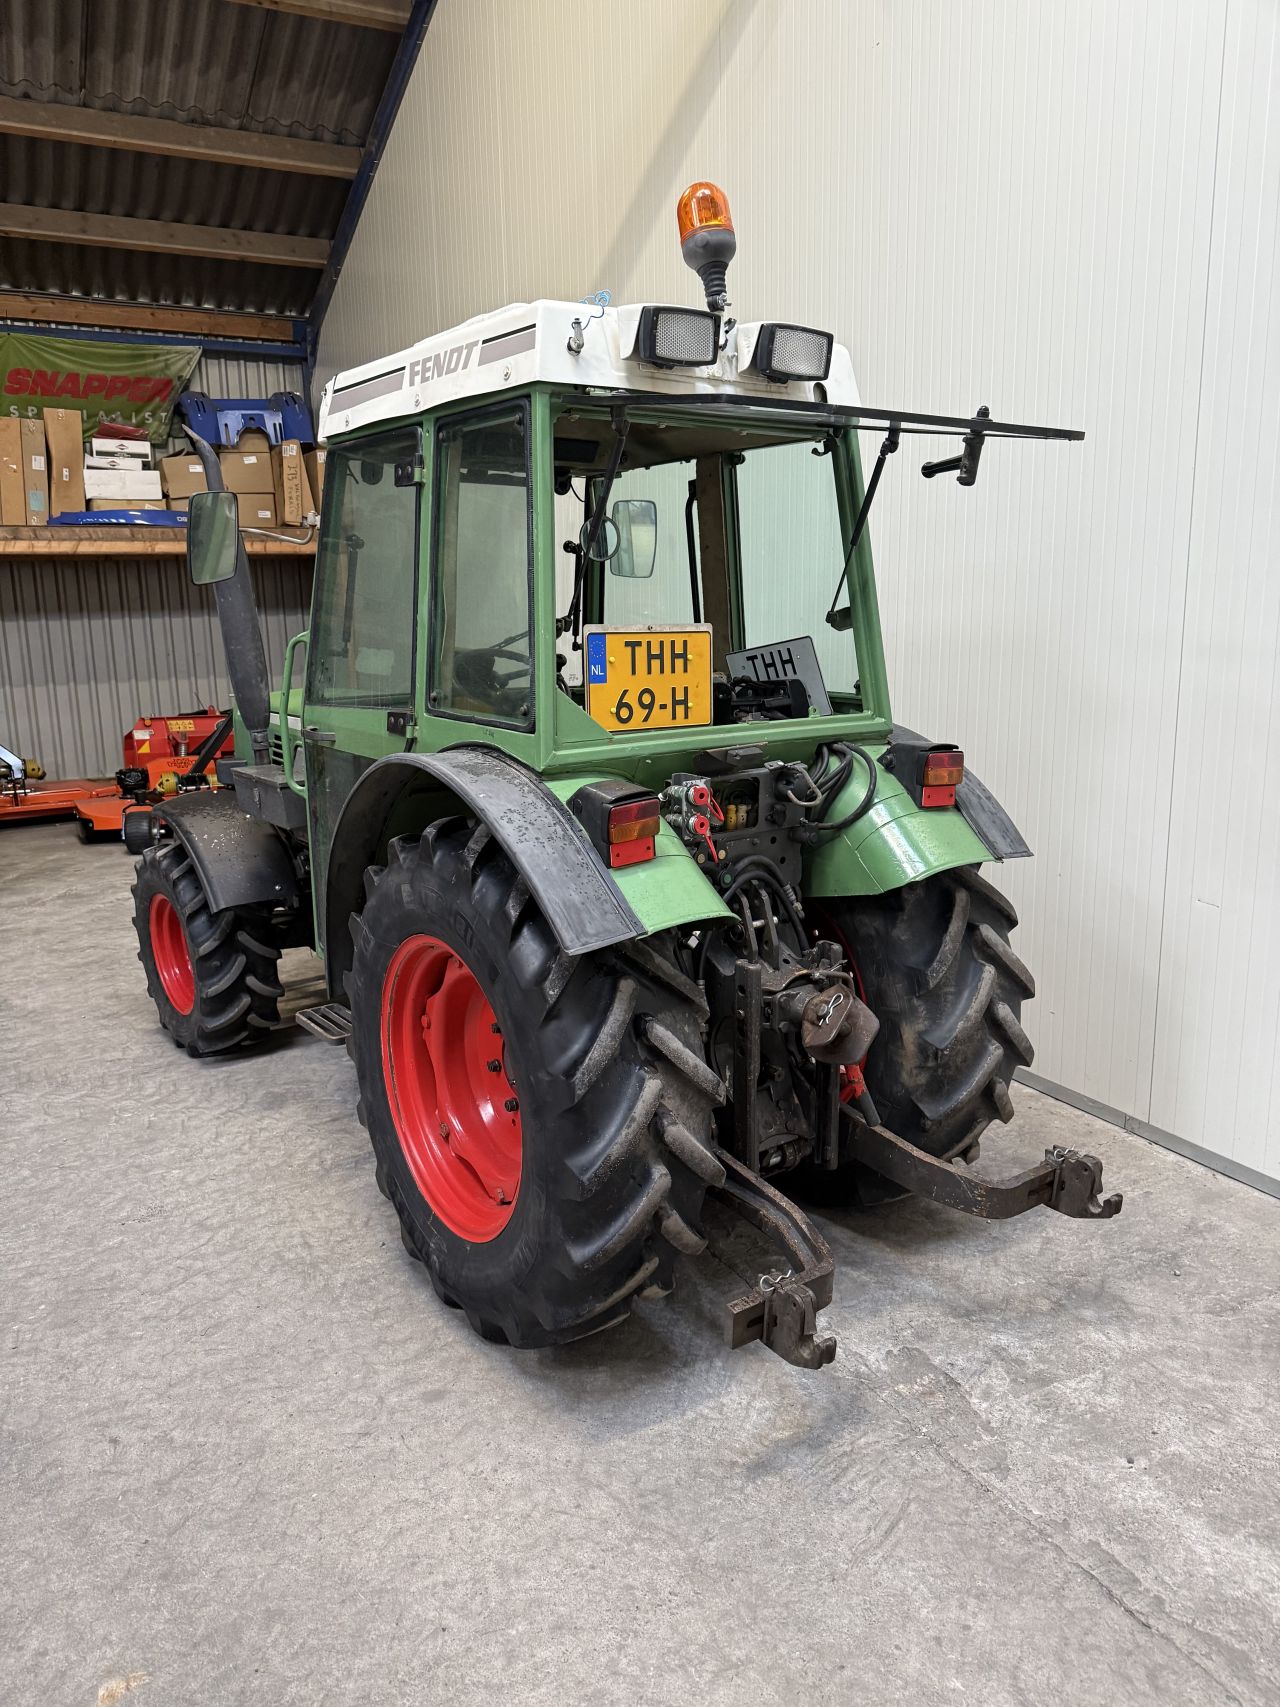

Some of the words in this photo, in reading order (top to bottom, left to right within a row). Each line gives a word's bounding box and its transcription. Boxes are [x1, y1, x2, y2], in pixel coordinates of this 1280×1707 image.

[409, 340, 479, 387] FENDT
[4, 368, 173, 404] SNAPPER
[9, 405, 168, 424] SPIAIST
[591, 665, 605, 676] NL
[624, 639, 688, 676] THH
[746, 647, 797, 682] THH
[614, 686, 689, 724] 69-H
